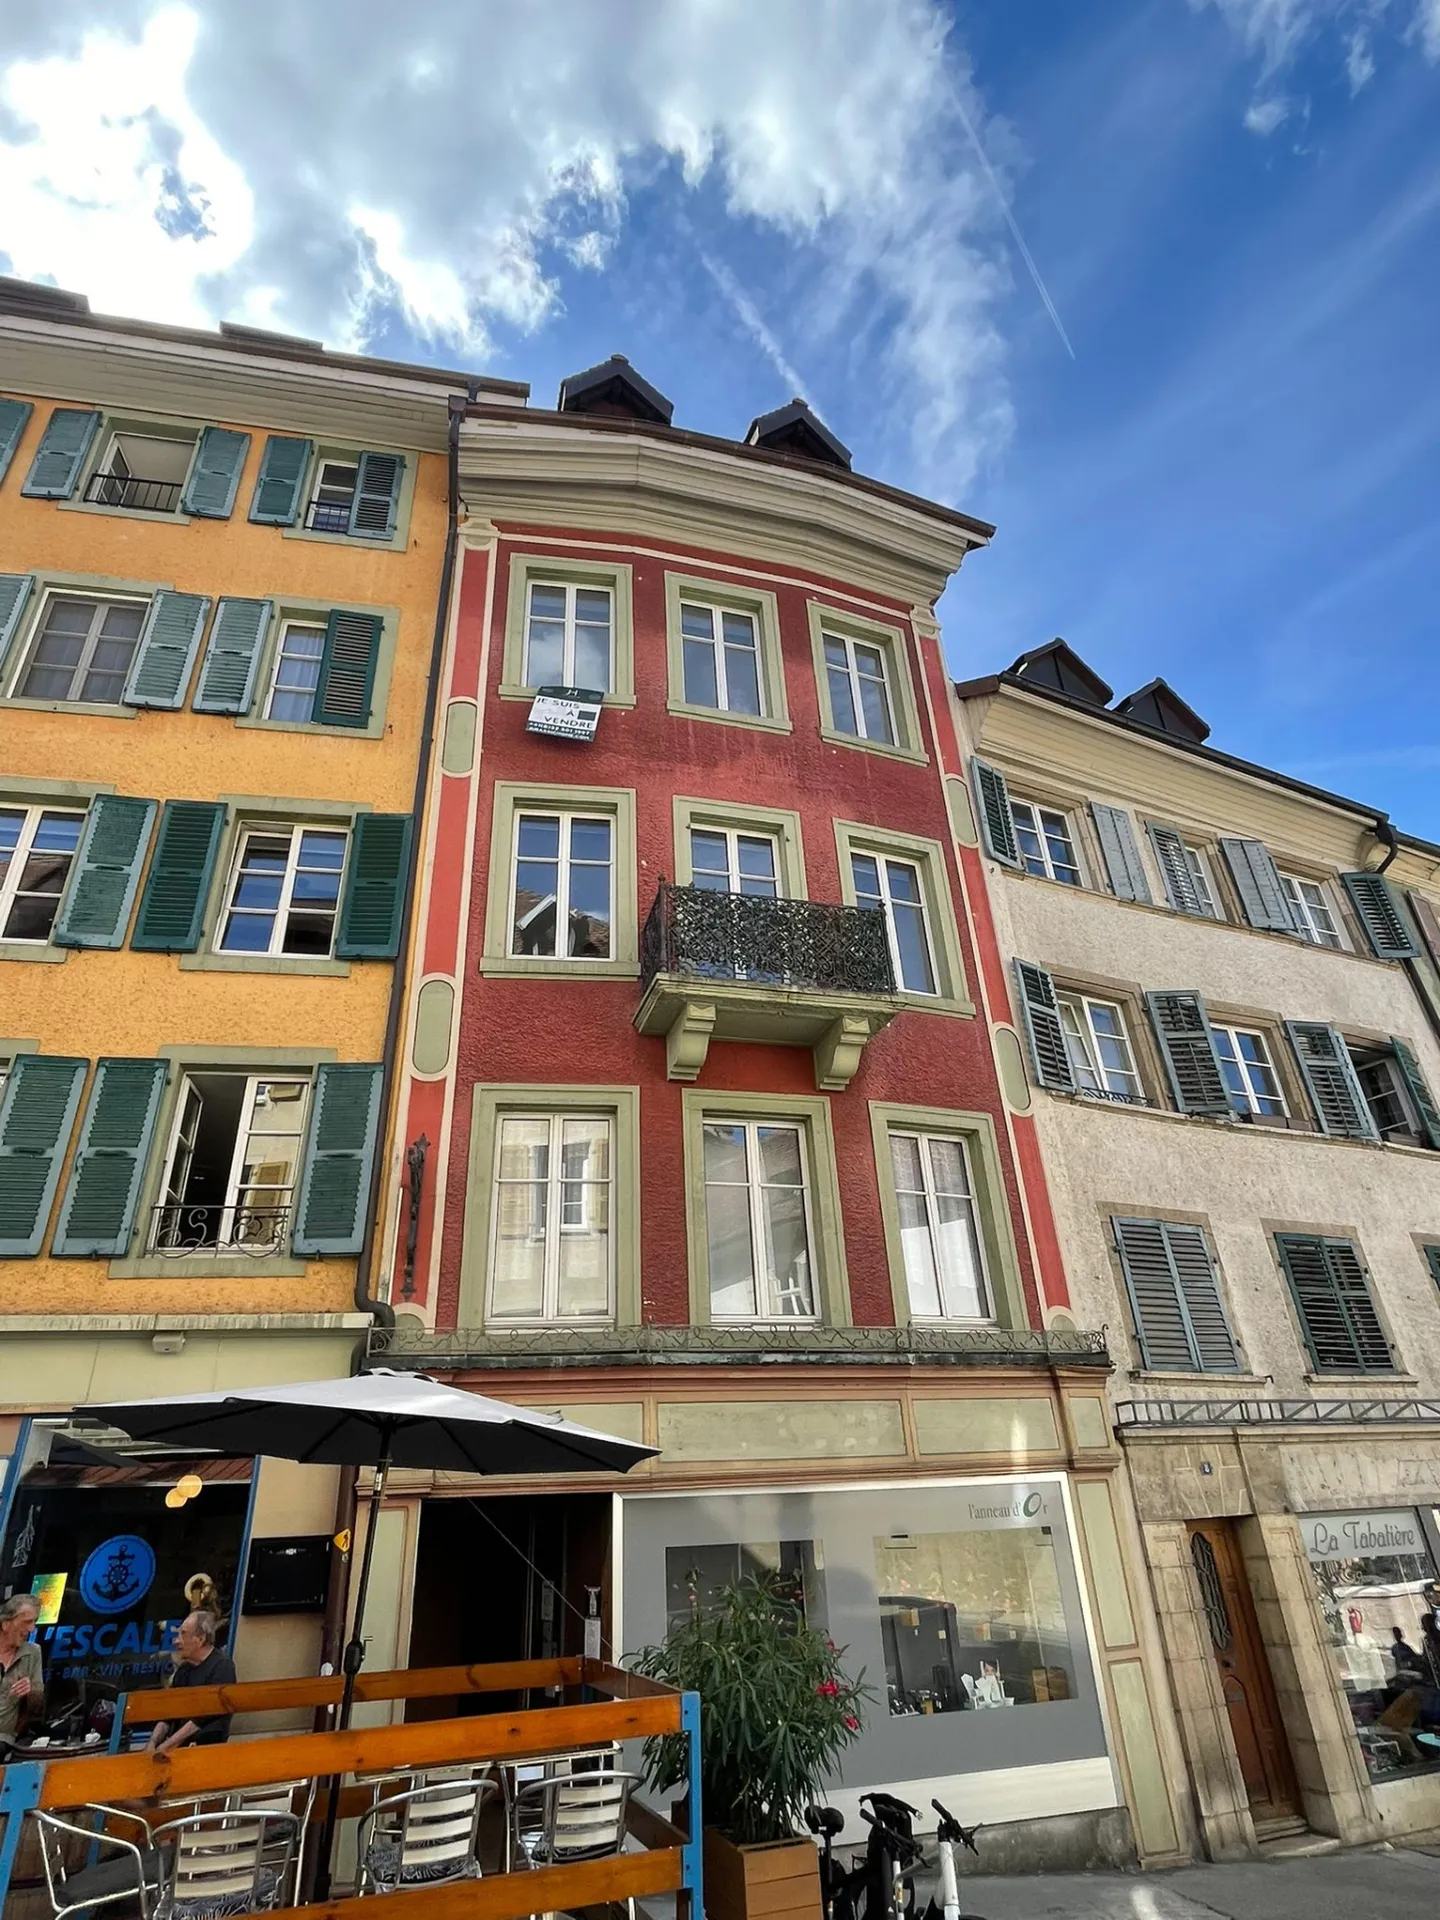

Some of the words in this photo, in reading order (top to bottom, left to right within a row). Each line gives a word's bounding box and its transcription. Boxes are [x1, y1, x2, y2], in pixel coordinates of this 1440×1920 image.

[553, 699, 580, 709] SUIS
[544, 716, 593, 729] VENDRE
[968, 1503, 1011, 1519] l'anneau
[1013, 1492, 1048, 1517] d'Or
[1310, 1522, 1339, 1555] La
[1342, 1521, 1415, 1549] Tabatière
[100, 1662, 124, 1677] VIN
